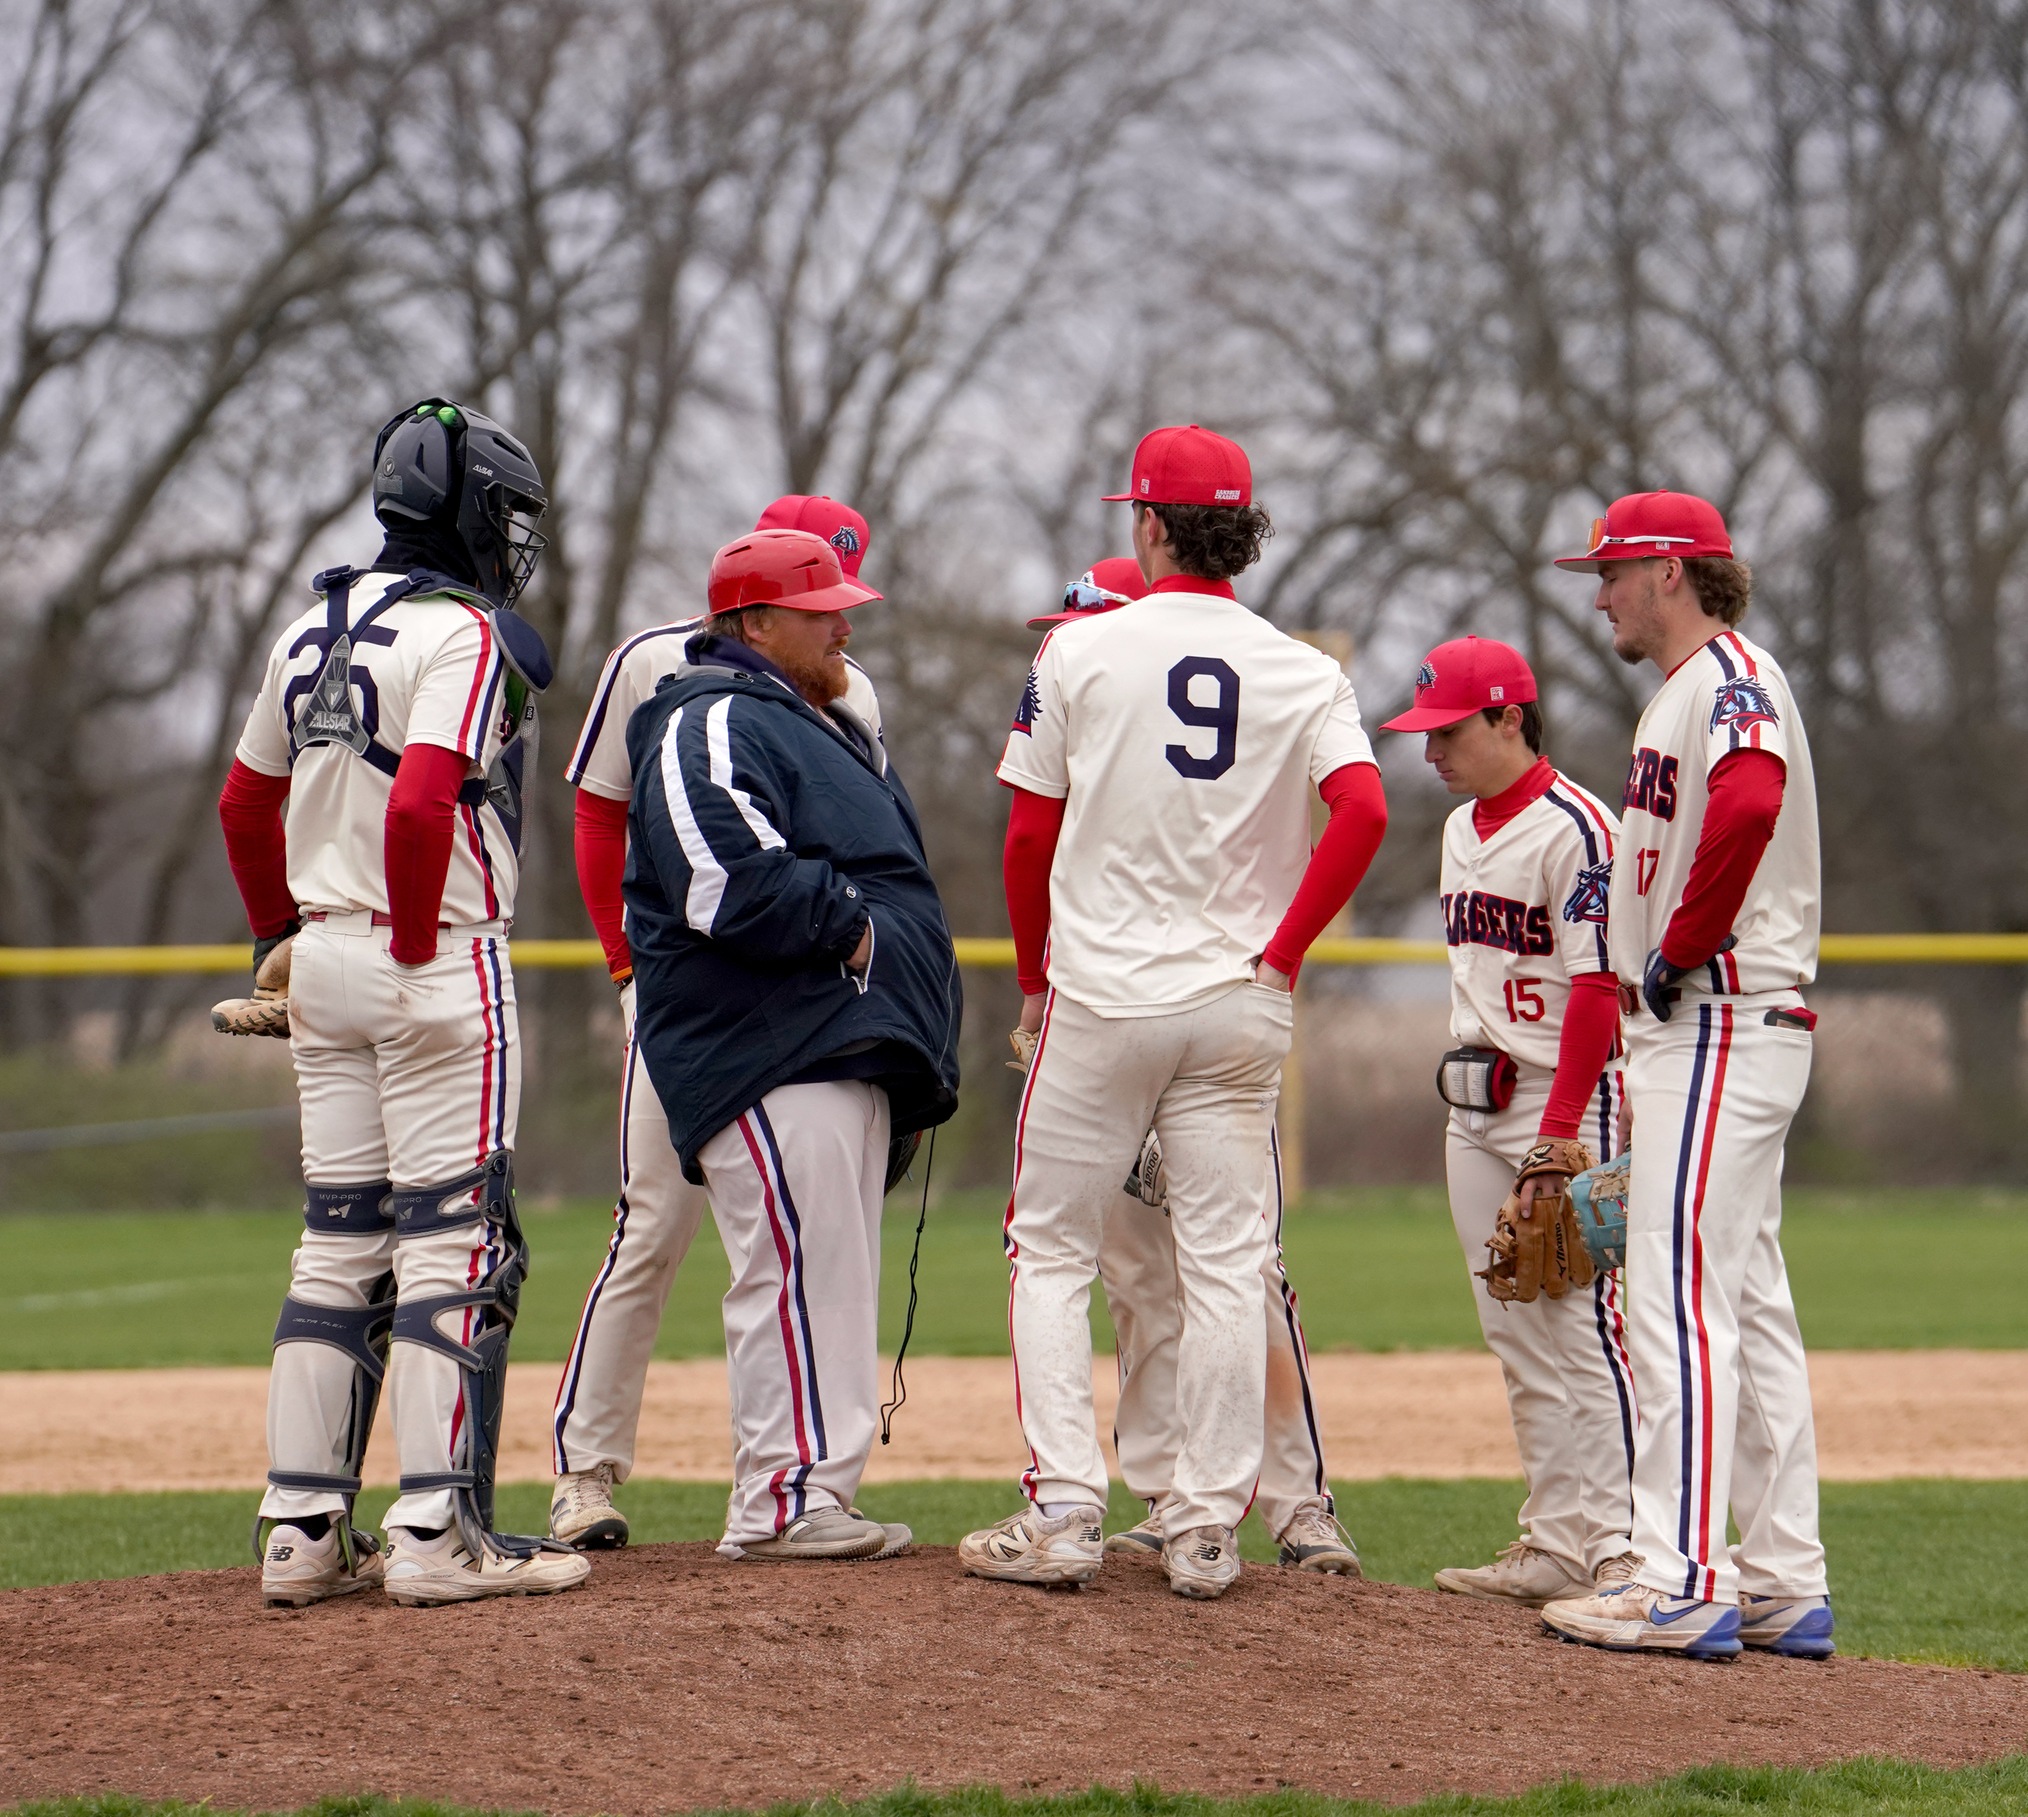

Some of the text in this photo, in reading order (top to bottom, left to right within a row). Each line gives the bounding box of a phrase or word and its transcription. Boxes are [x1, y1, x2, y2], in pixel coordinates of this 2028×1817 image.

[309, 711, 352, 731] ALL-STAR
[1165, 655, 1240, 780] 9
[1636, 847, 1660, 897] 17
[1503, 978, 1545, 1023] 15
[1145, 1152, 1159, 1189] A2000
